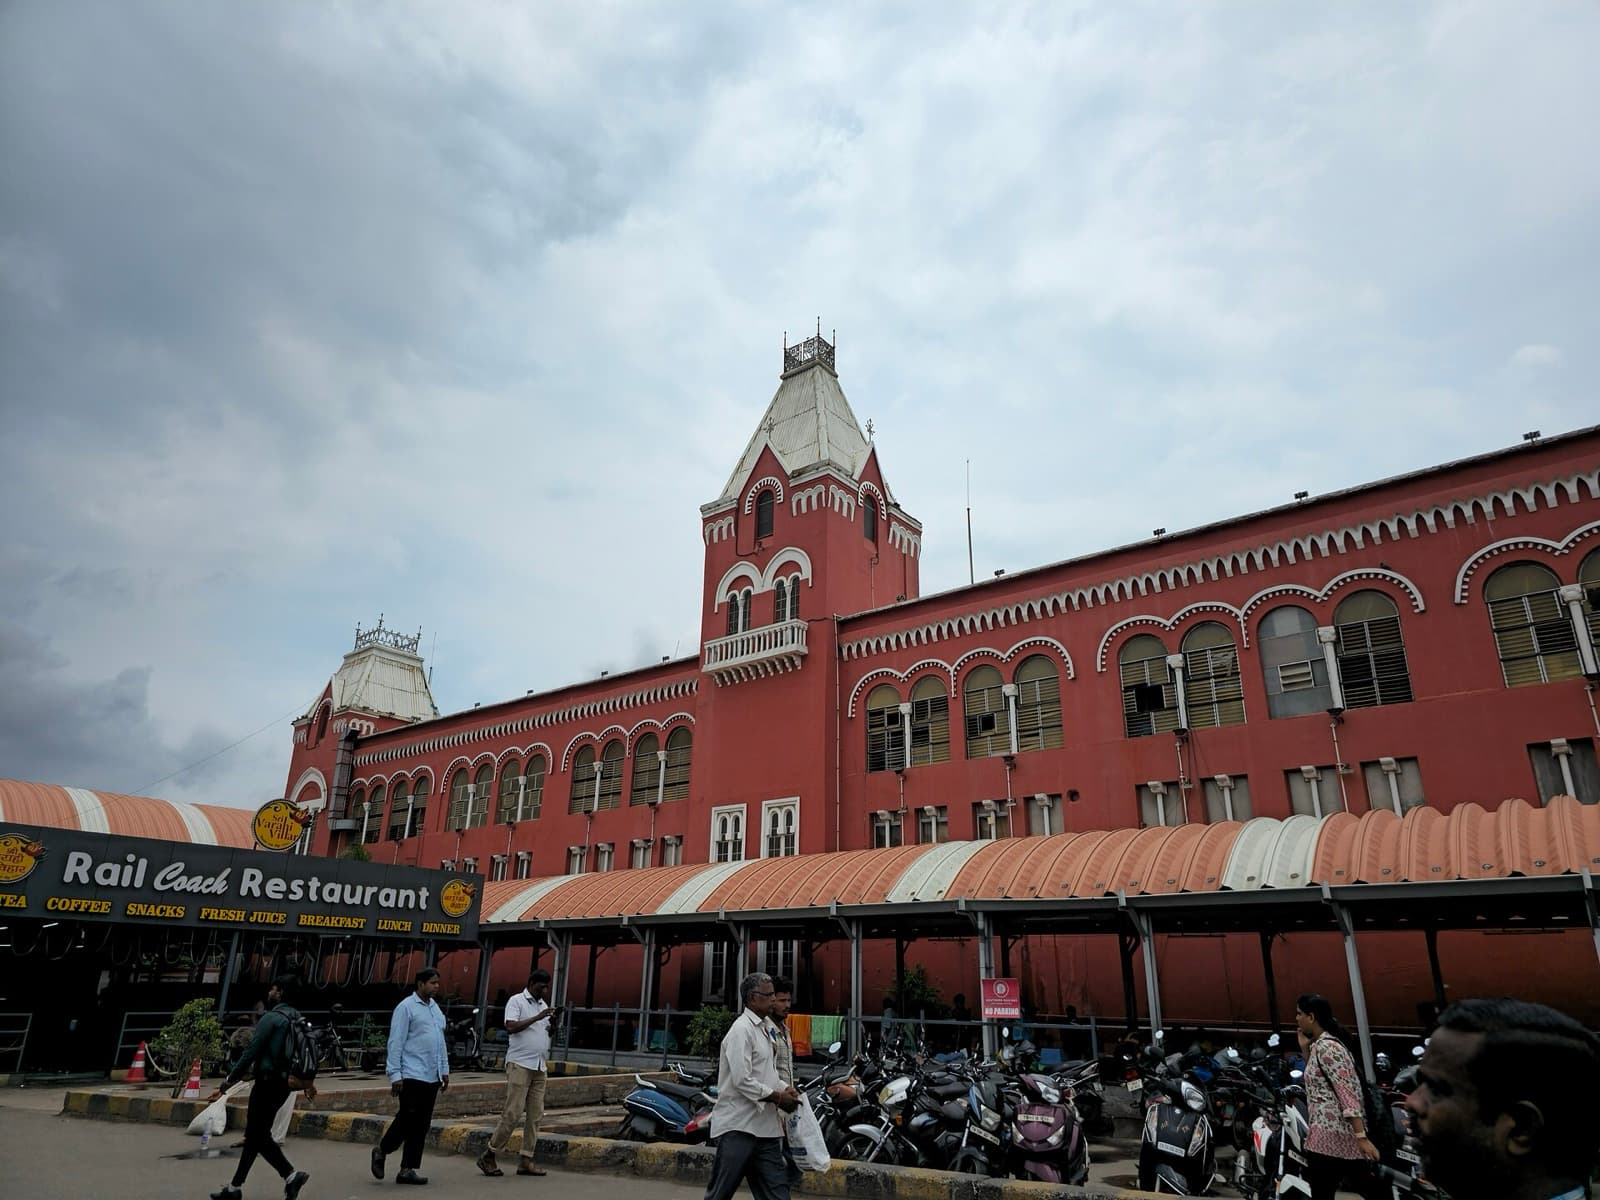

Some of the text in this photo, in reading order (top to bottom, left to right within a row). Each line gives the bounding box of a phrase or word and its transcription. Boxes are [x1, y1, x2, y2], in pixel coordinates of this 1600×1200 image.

[63, 851, 430, 911] Rail Coach Restaurant
[46, 897, 112, 914] COFFEE
[126, 902, 186, 918] SNACKS
[200, 907, 247, 922] FRESH
[249, 911, 287, 924] JUICE
[299, 914, 366, 929] BREAKFAST
[377, 919, 412, 932] LUNCH
[422, 922, 460, 935] DINNER
[985, 1007, 1018, 1015] NO PARKING
